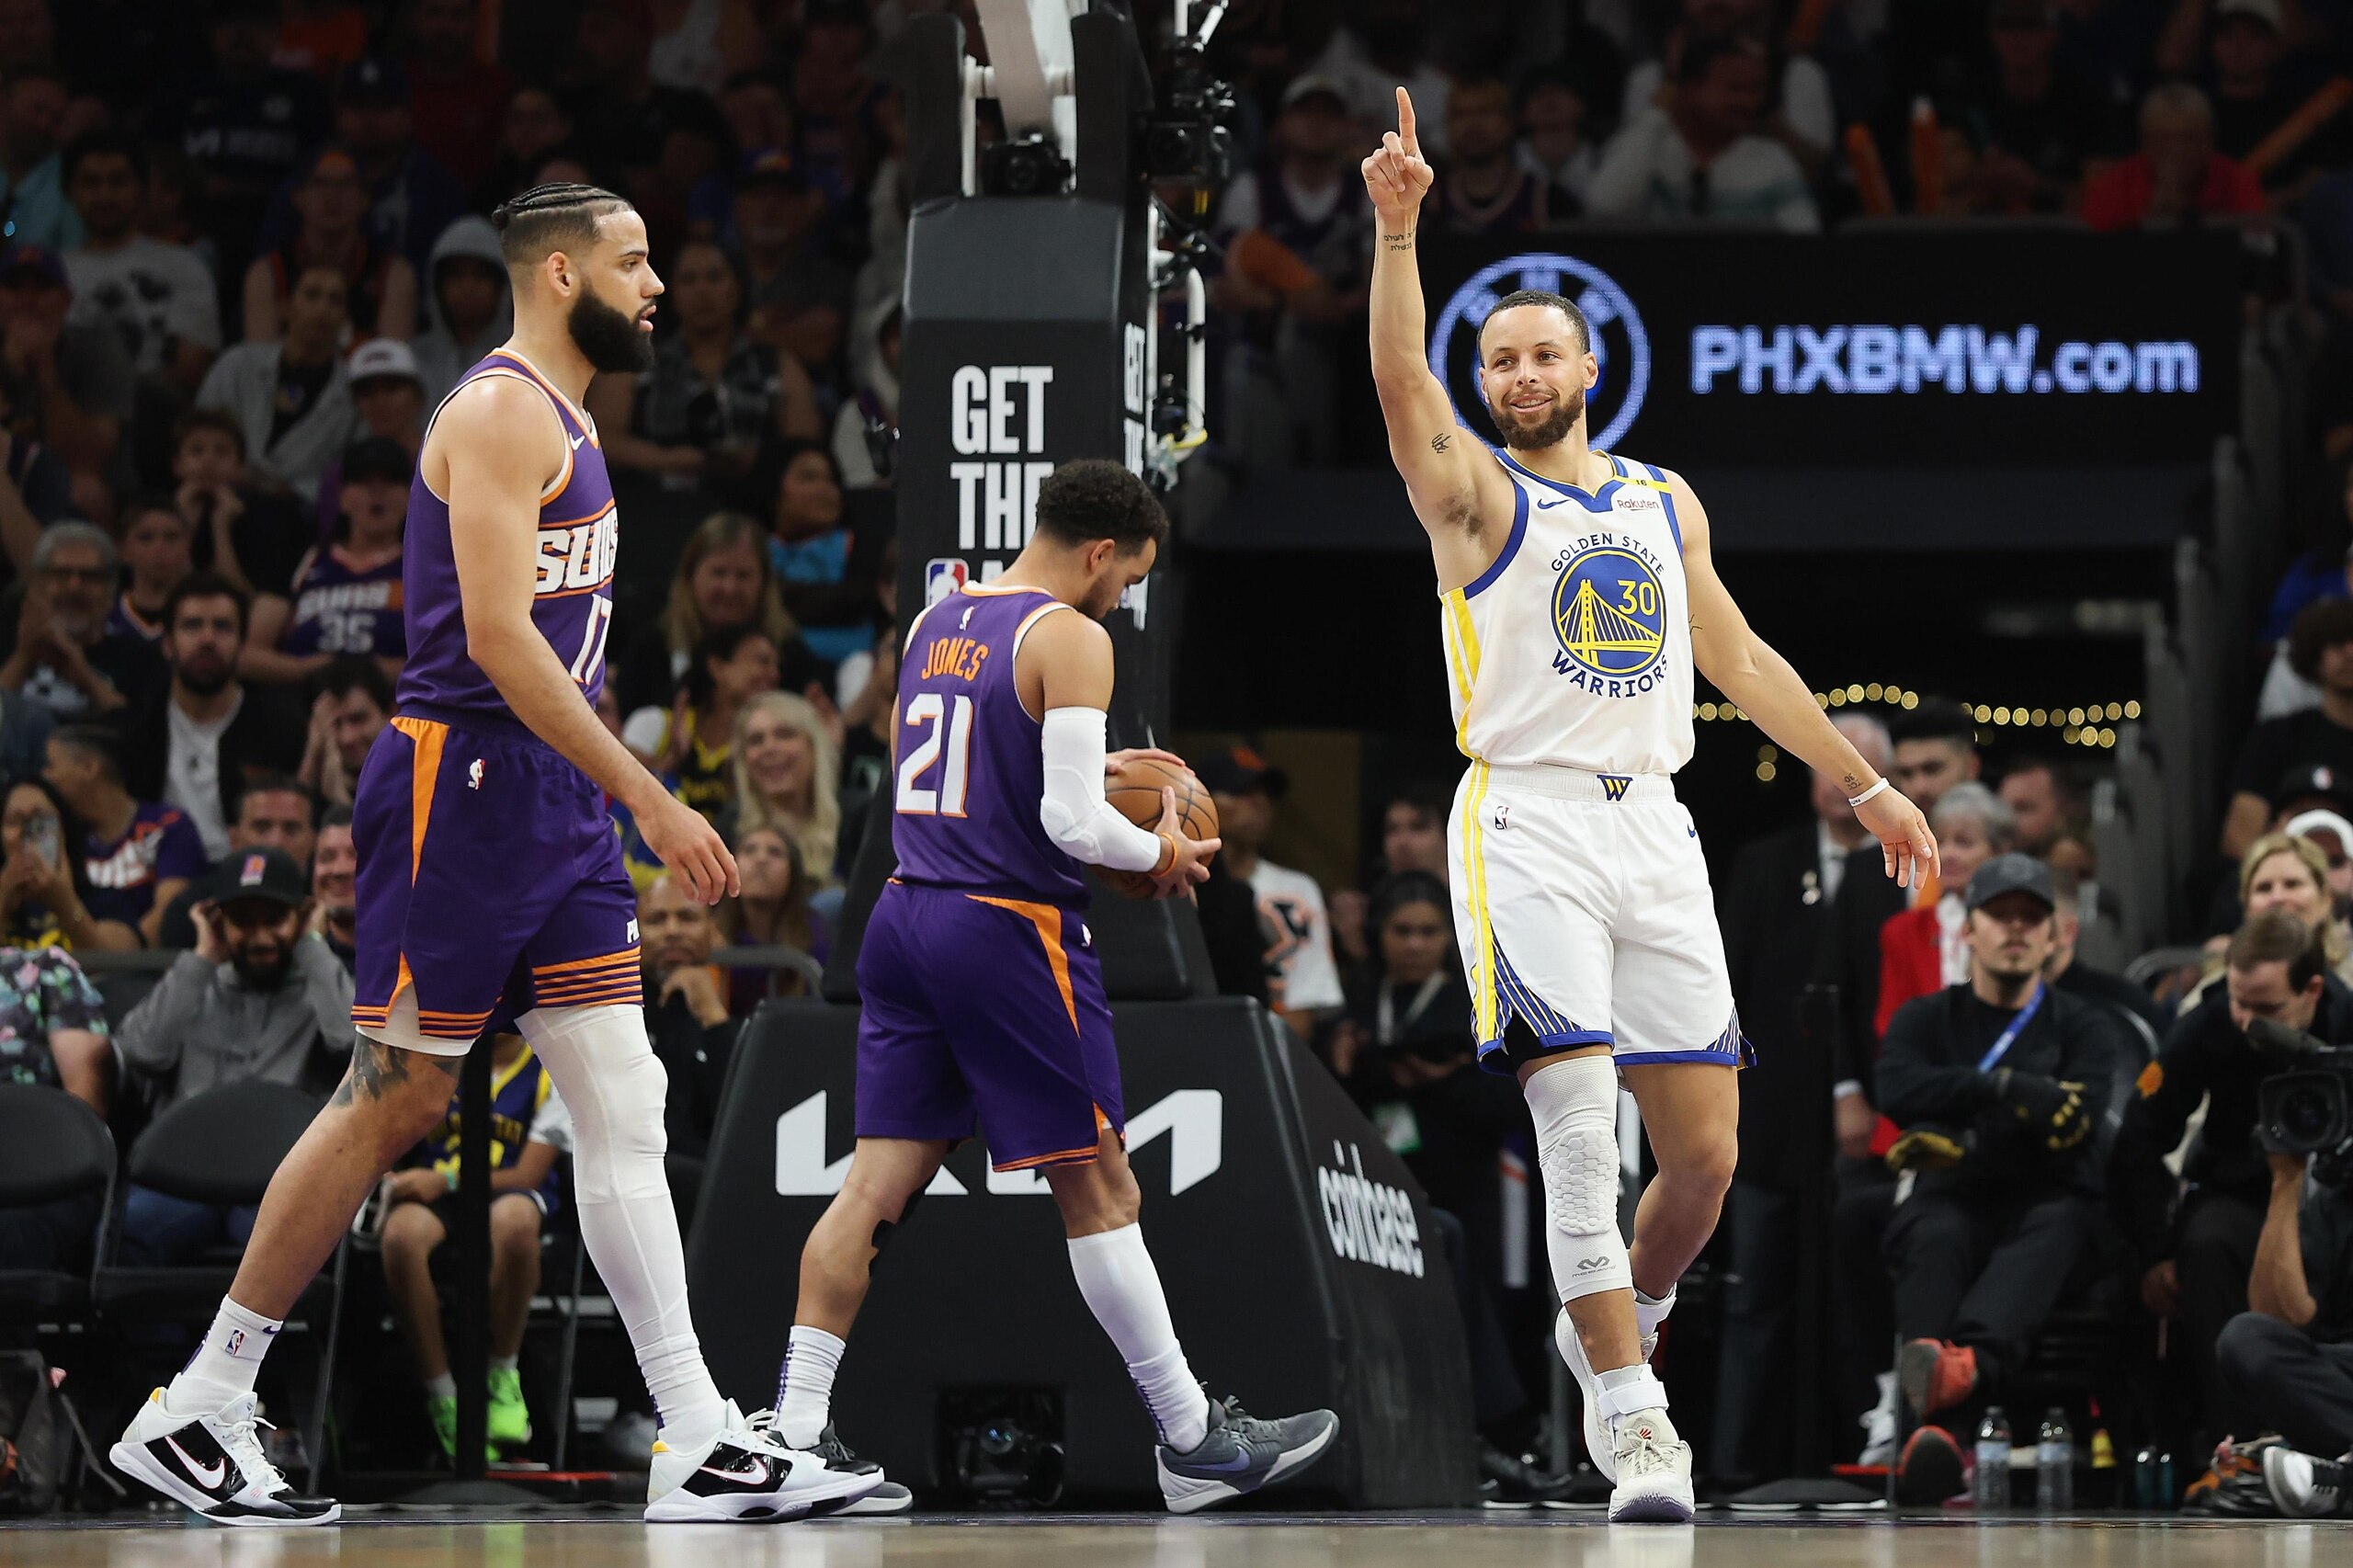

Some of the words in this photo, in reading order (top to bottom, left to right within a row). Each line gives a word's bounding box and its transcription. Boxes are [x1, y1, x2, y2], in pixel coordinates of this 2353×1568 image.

[1690, 324, 2200, 394] PHXBMW.com
[950, 365, 1054, 455] GET
[1616, 498, 1660, 509] Rakuten
[1551, 532, 1614, 572] GOLDEN
[1621, 536, 1665, 576] STATE
[1617, 578, 1656, 617] 30
[570, 593, 613, 686] 17
[921, 637, 990, 682] JONES
[1552, 648, 1667, 699] WARRIORS
[895, 693, 973, 818] 21
[775, 1088, 1223, 1196] KA
[1317, 1138, 1425, 1279] coinbase
